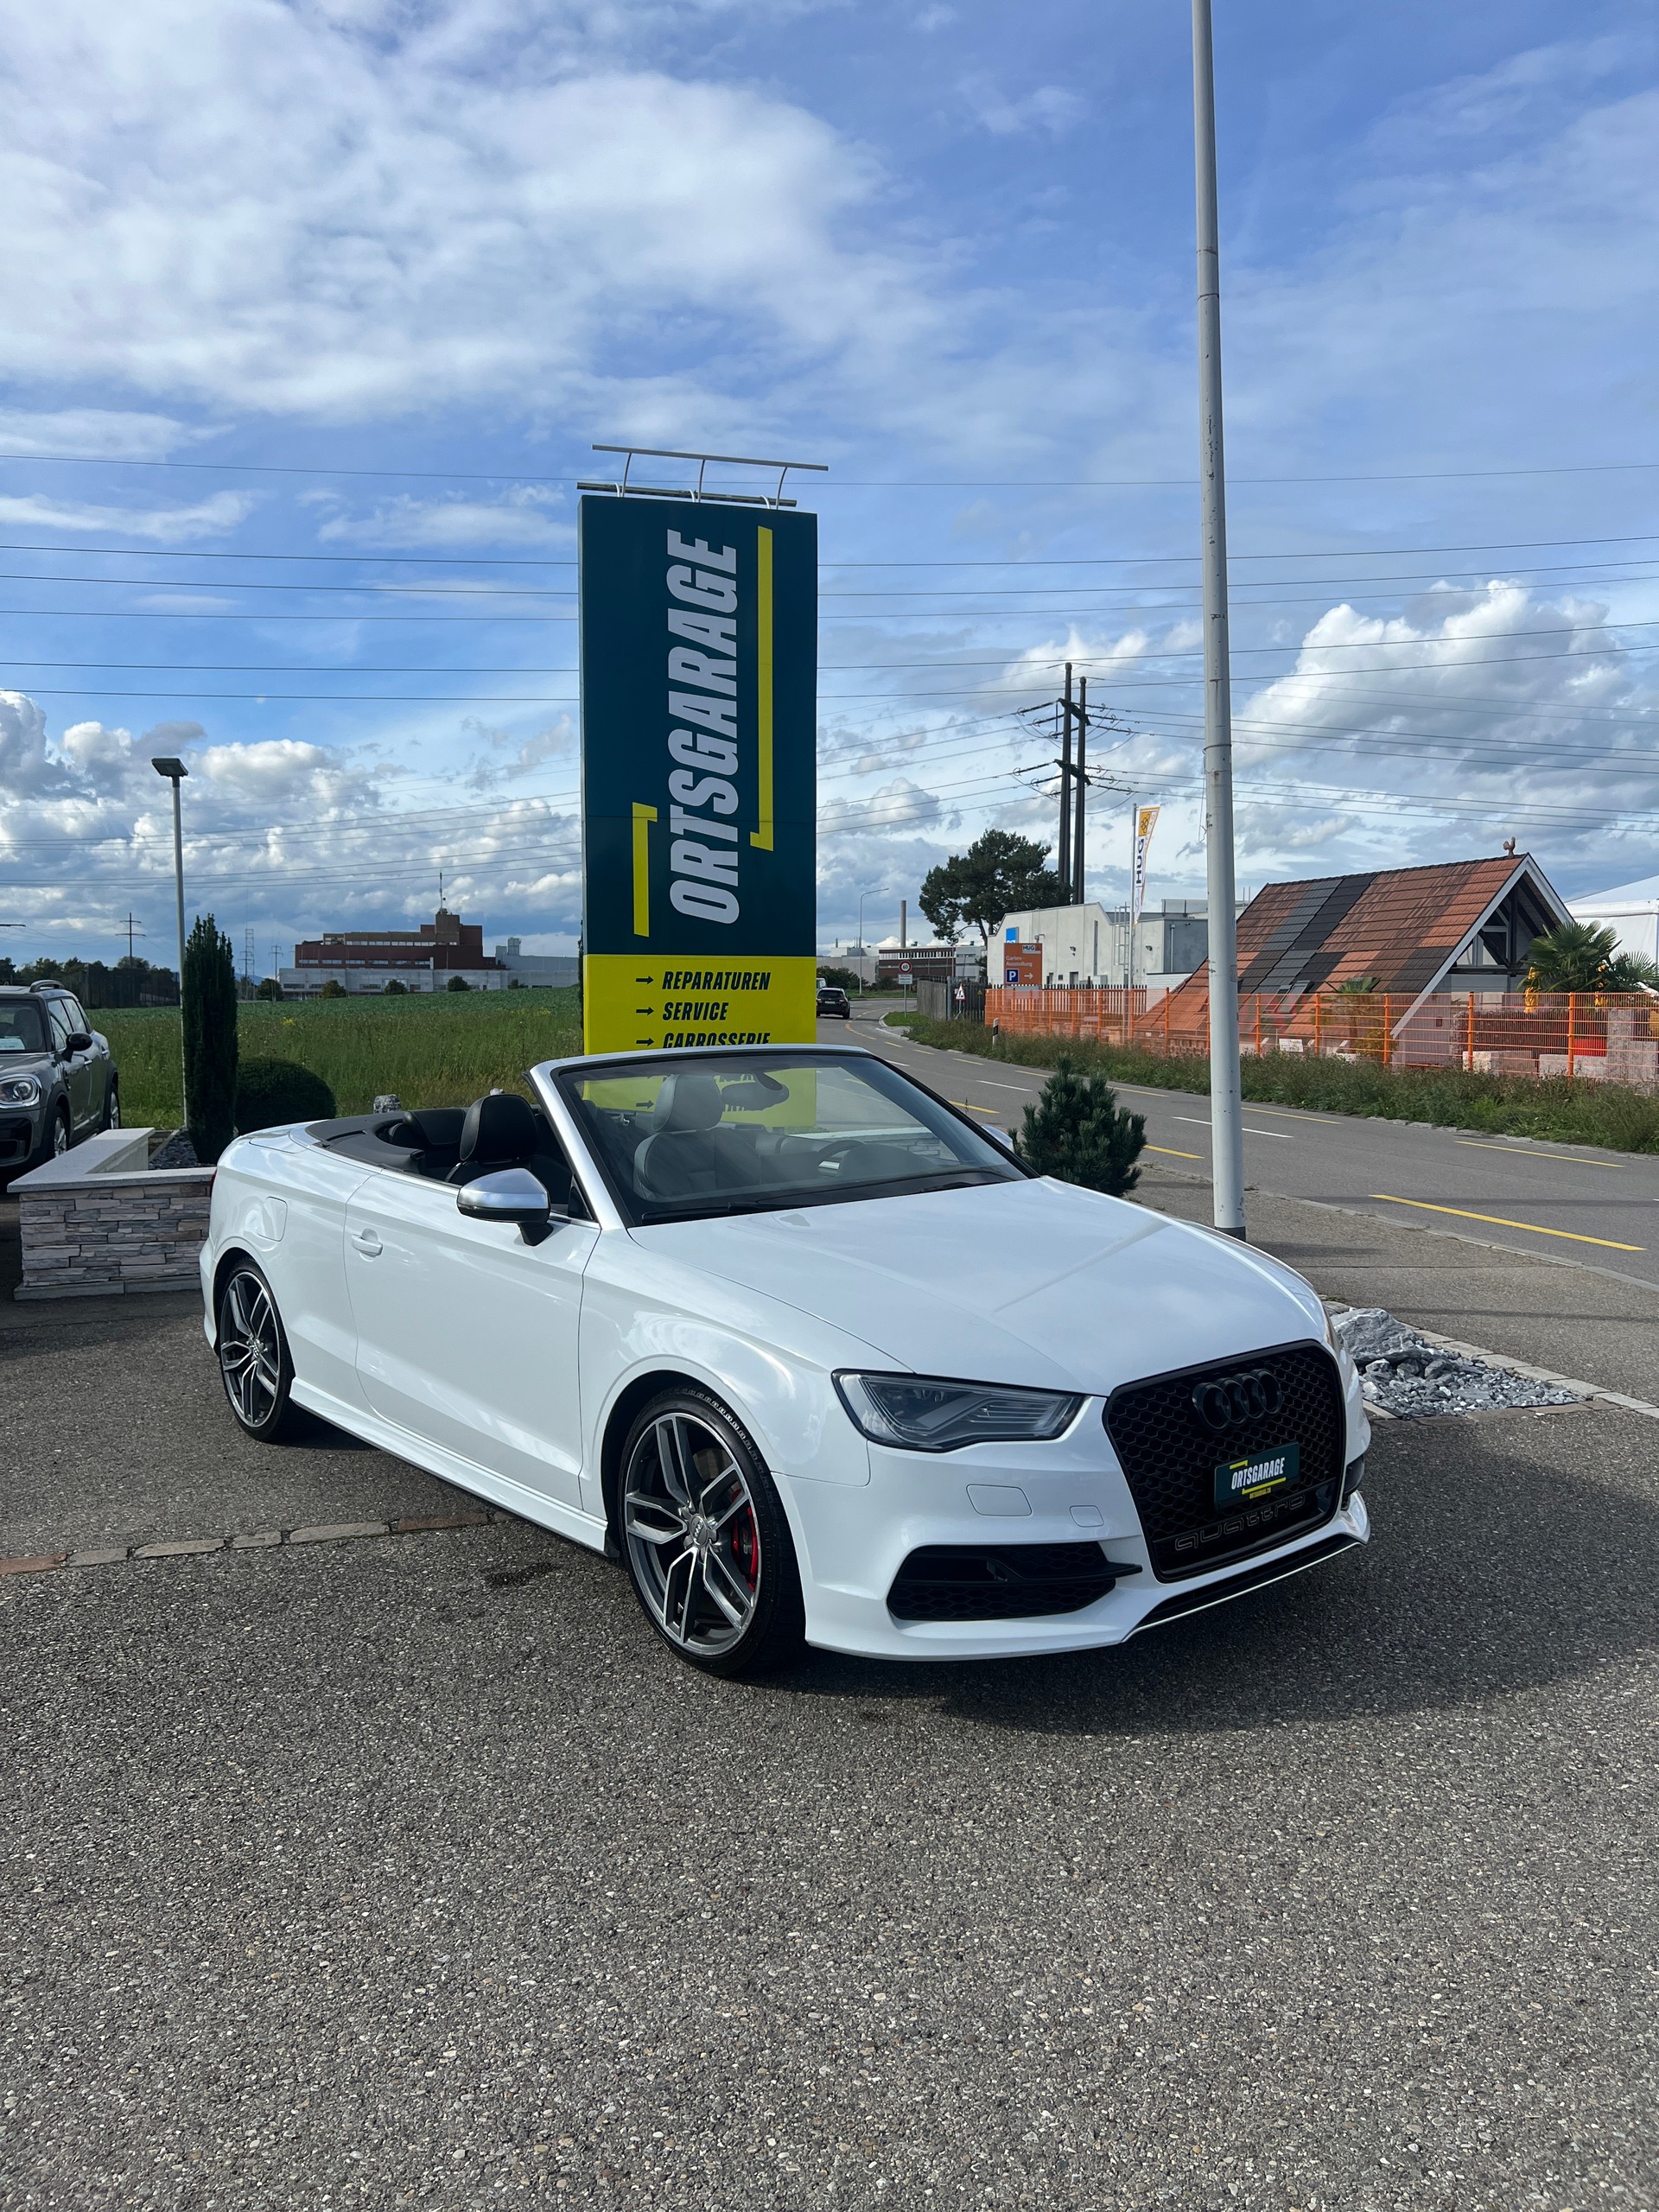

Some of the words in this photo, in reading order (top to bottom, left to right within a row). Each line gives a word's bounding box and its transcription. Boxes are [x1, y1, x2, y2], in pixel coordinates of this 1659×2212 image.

[666, 529, 739, 924] ORTSGARAGE
[1135, 838, 1144, 884] HUG
[662, 971, 772, 991] REPARATUREN
[662, 1001, 729, 1020] SERVICE
[1230, 1457, 1286, 1490] ORTSGARAGE
[1174, 1494, 1306, 1552] quattro
